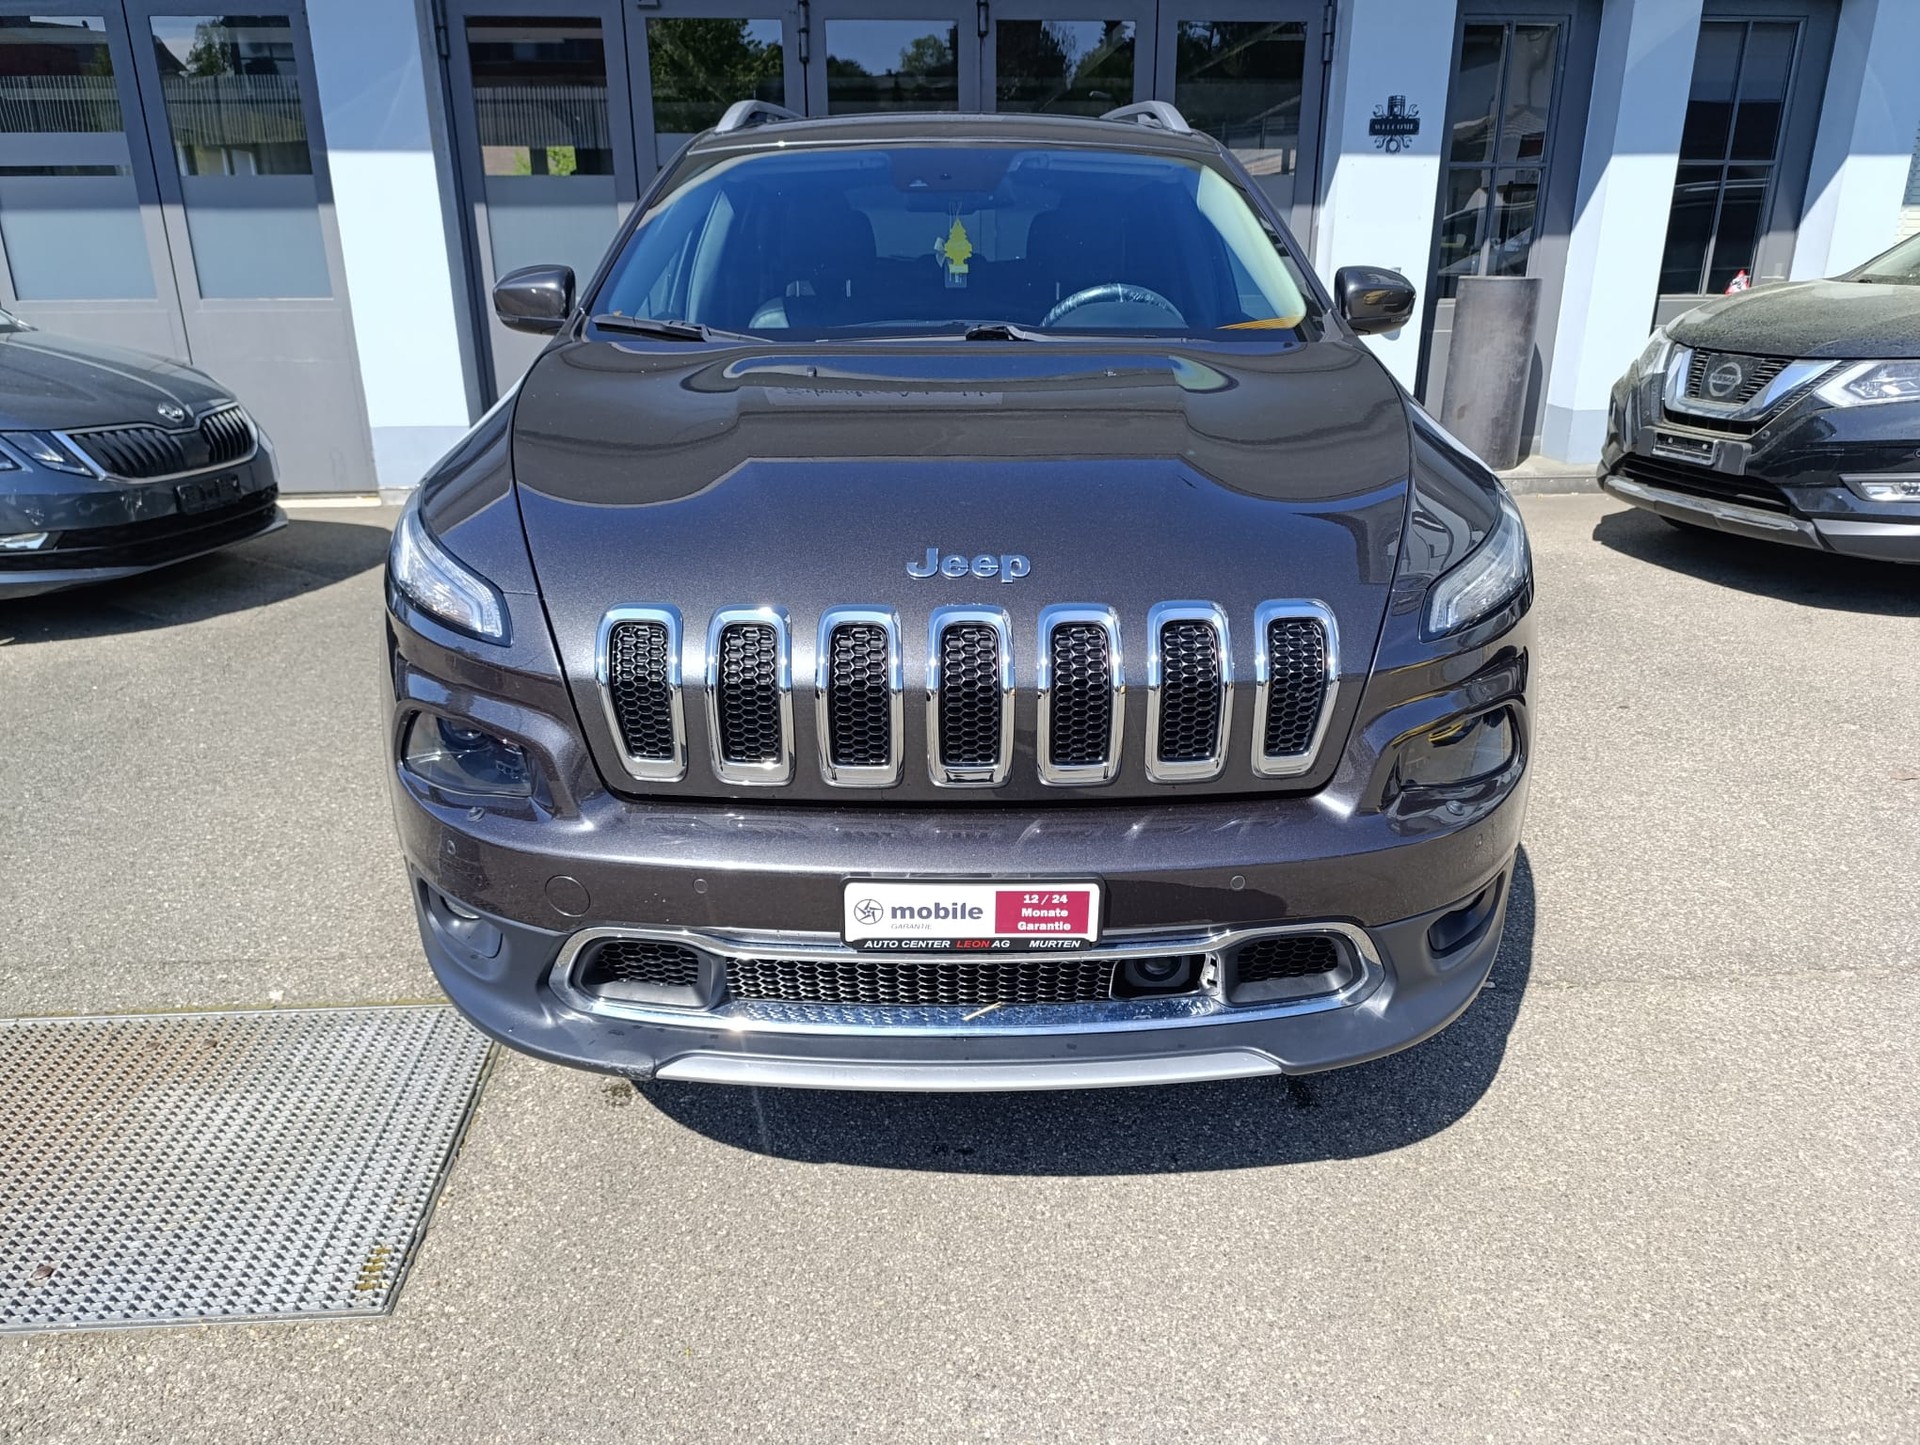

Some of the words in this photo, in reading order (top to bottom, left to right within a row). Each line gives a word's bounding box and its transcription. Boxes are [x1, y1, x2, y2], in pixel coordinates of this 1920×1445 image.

[906, 548, 1031, 584] Jeep
[1023, 894, 1040, 904] 12
[1040, 894, 1050, 906] /
[1051, 894, 1069, 904] 24
[891, 902, 984, 920] mobile
[1021, 907, 1069, 918] Monate
[1017, 921, 1072, 931] Garantie
[864, 940, 899, 949] AUTO
[901, 940, 951, 949] CENTER
[956, 940, 990, 949] LEON
[991, 940, 1011, 949] AG
[1029, 940, 1081, 949] MURTEN
